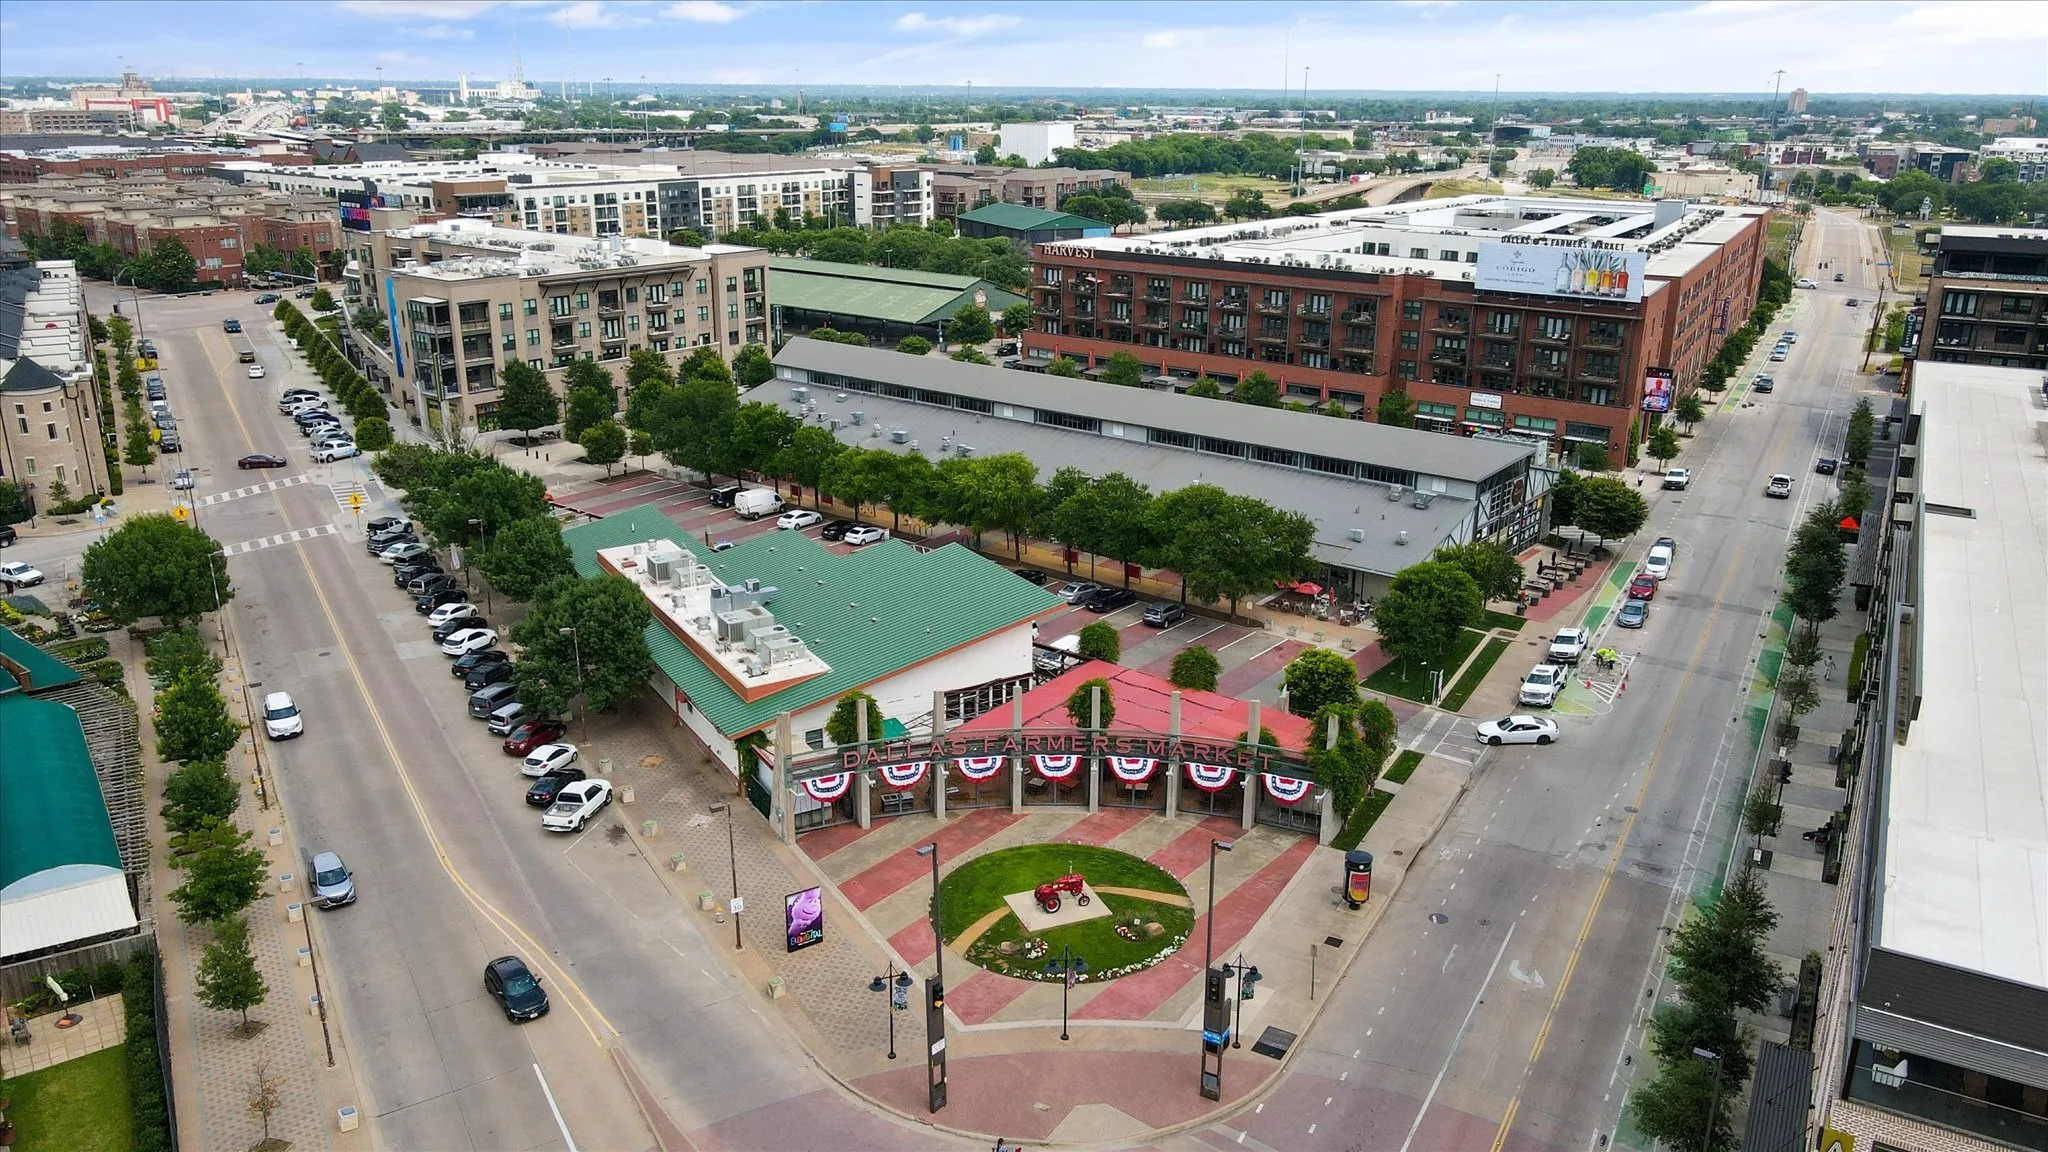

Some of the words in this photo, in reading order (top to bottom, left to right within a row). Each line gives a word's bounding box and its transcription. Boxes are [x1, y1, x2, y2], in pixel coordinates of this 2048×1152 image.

[1044, 243, 1096, 259] HARVEST
[1501, 235, 1530, 245] DALLAS
[1550, 238, 1588, 249] FARMERS
[1591, 240, 1625, 251] MARKET
[843, 739, 967, 769] DALLAS
[984, 736, 1132, 754] FARMERS
[1146, 740, 1276, 771] MARKET
